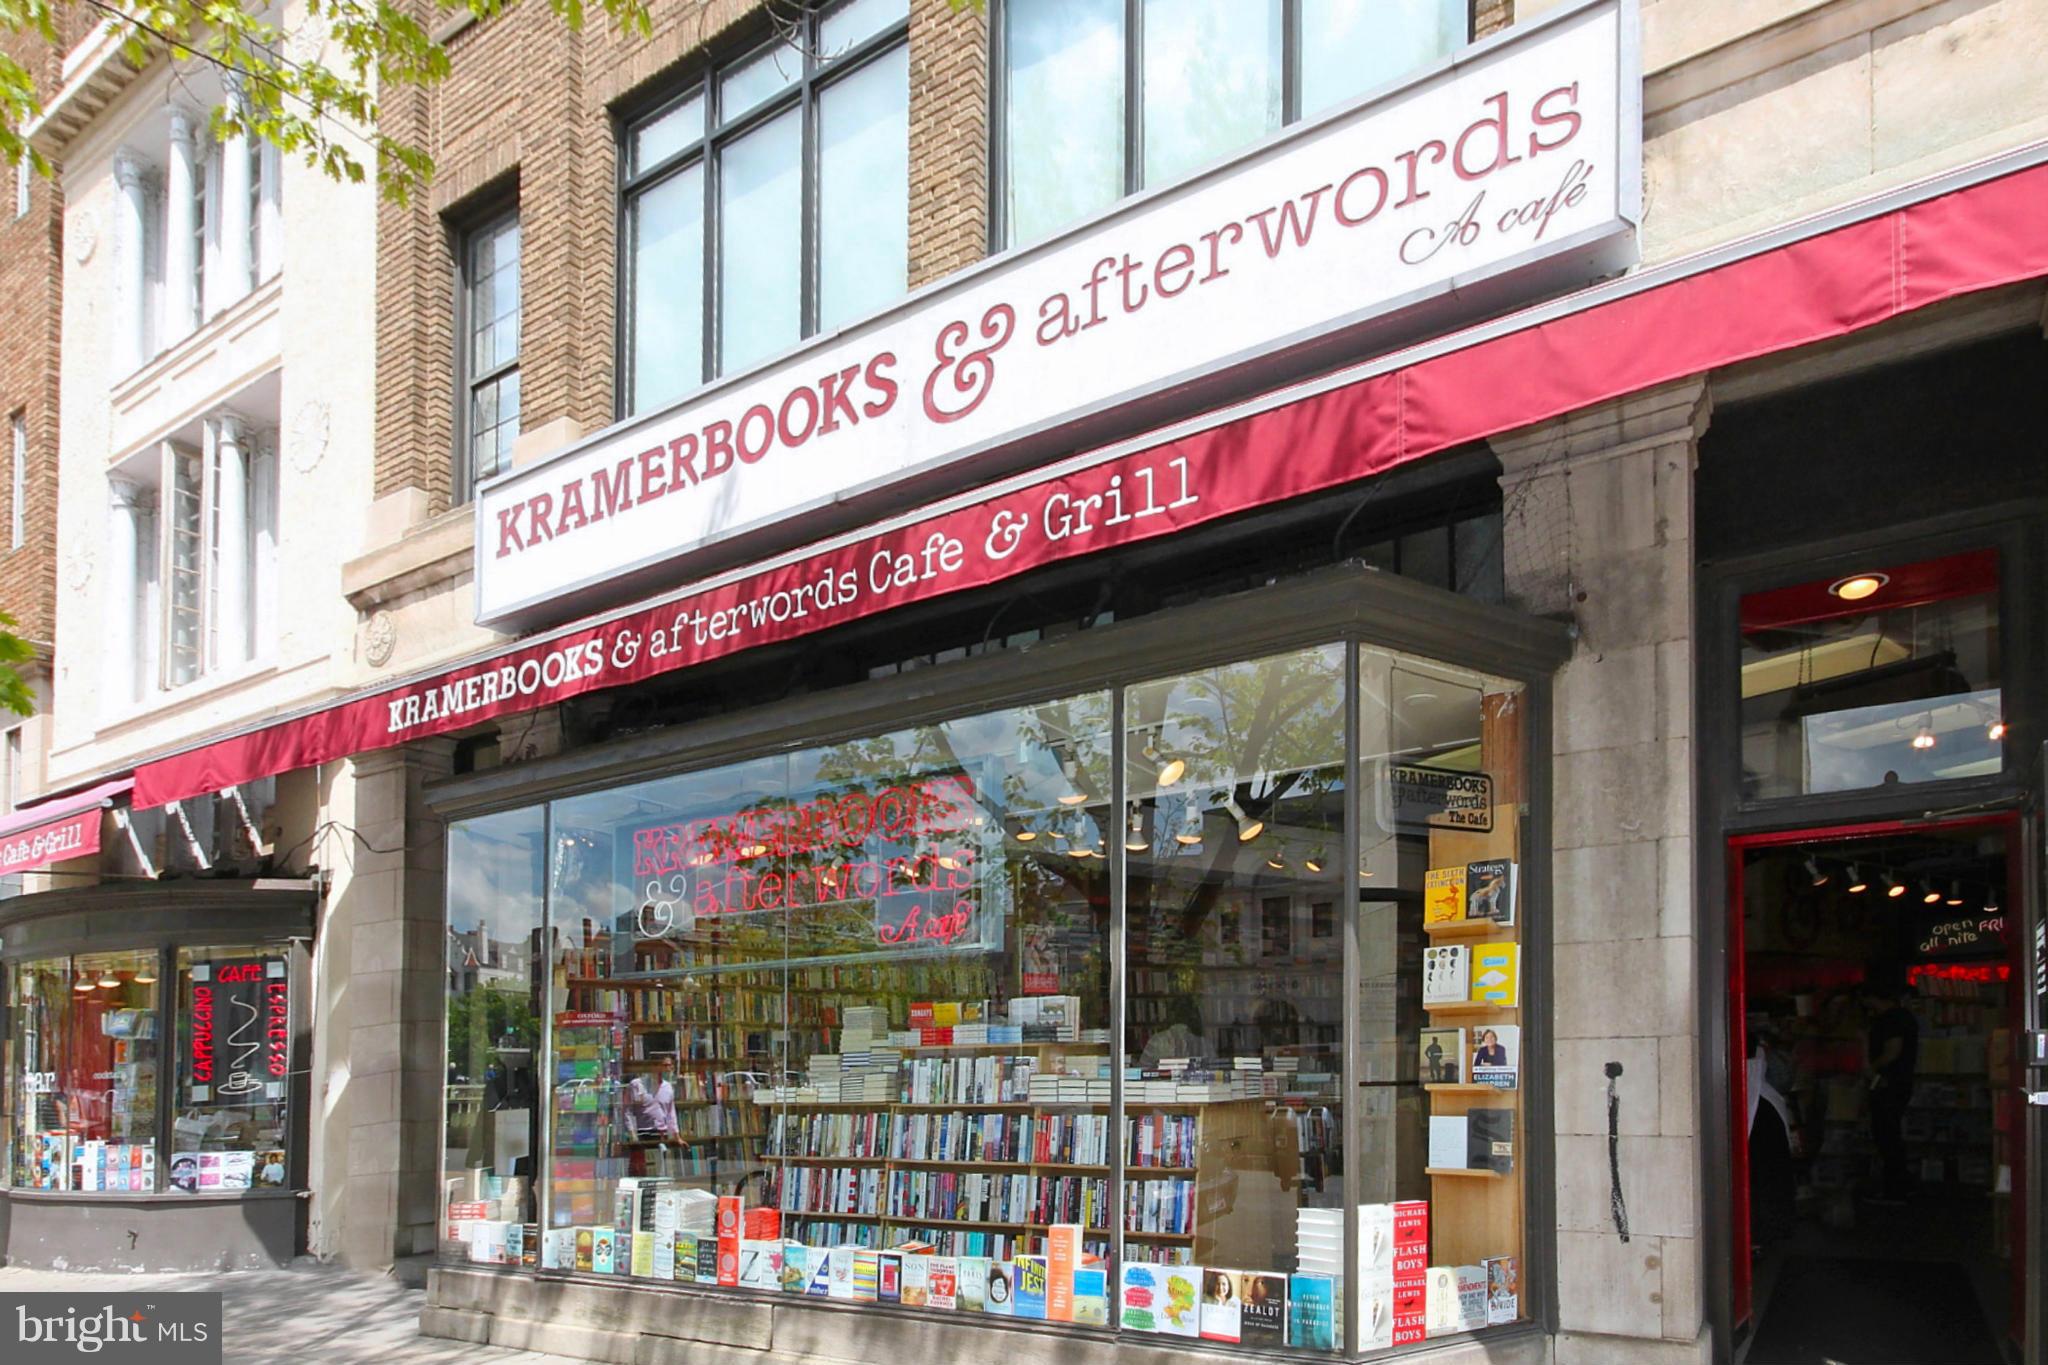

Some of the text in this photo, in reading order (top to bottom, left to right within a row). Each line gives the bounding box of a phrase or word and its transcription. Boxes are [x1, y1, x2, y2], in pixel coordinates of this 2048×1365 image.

[1399, 157, 1594, 266] A café
[496, 80, 1583, 560] KRAMERBOOKS & afterwords
[387, 456, 1199, 733] KRAMERBOOKS & afterwords Cafe & Grill
[1390, 768, 1487, 794] KRAMERBOOKS
[1407, 787, 1487, 809] afterwords
[1449, 811, 1488, 826] The Cafe
[3, 840, 30, 866] Cafe
[45, 824, 82, 854] Grill
[694, 842, 975, 915] afterwords
[1469, 864, 1505, 875] Strategy
[1932, 920, 1973, 935] open
[1920, 932, 1978, 951] all nite
[217, 964, 263, 983] CAFE
[192, 986, 214, 1082] CAPPUCCINO
[265, 983, 288, 1076] ESPRESSO
[25, 1066, 55, 1093] bar
[1473, 1073, 1514, 1081] ELIZABETH
[1398, 1219, 1421, 1228] LEWIS
[1393, 1244, 1427, 1257] FLASH
[1397, 1259, 1423, 1271] BOYS
[1020, 1271, 1045, 1294] JEST
[1398, 1289, 1420, 1299] LEWIS
[1243, 1303, 1280, 1317] ZEALOT
[1392, 1315, 1425, 1328] FLASH
[1395, 1329, 1421, 1342] BOYS
